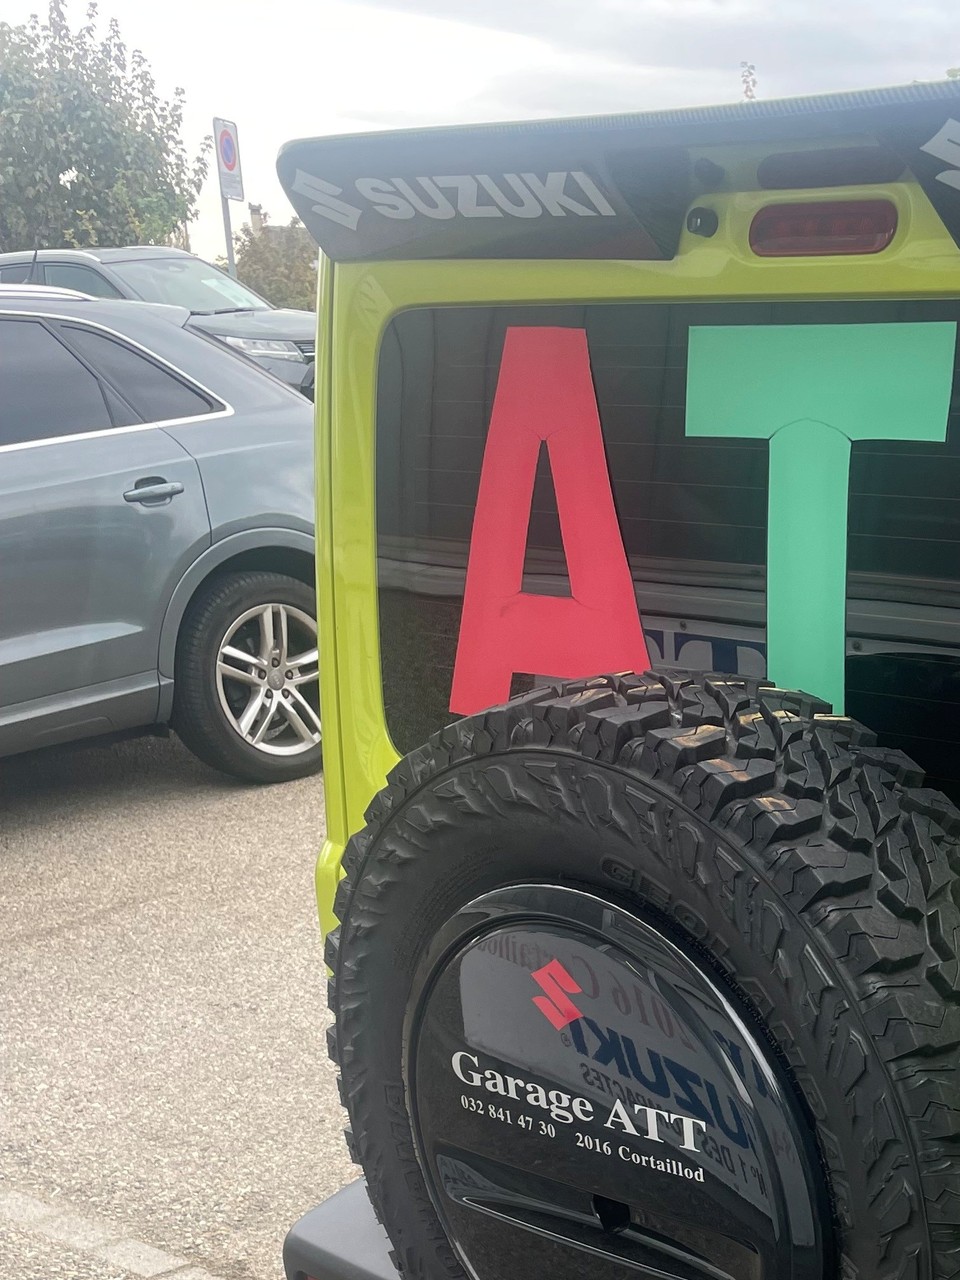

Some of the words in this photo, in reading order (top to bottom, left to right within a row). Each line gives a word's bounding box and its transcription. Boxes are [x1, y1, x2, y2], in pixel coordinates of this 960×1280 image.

[354, 170, 617, 220] SUZUKI
[451, 1050, 595, 1125] Garage
[604, 1098, 707, 1153] ATT
[460, 1094, 485, 1116] 032
[488, 1104, 513, 1125] 841
[517, 1115, 534, 1132] 47
[538, 1120, 556, 1139] 30
[575, 1132, 612, 1156] 2016
[618, 1145, 706, 1183] Cortaillod
